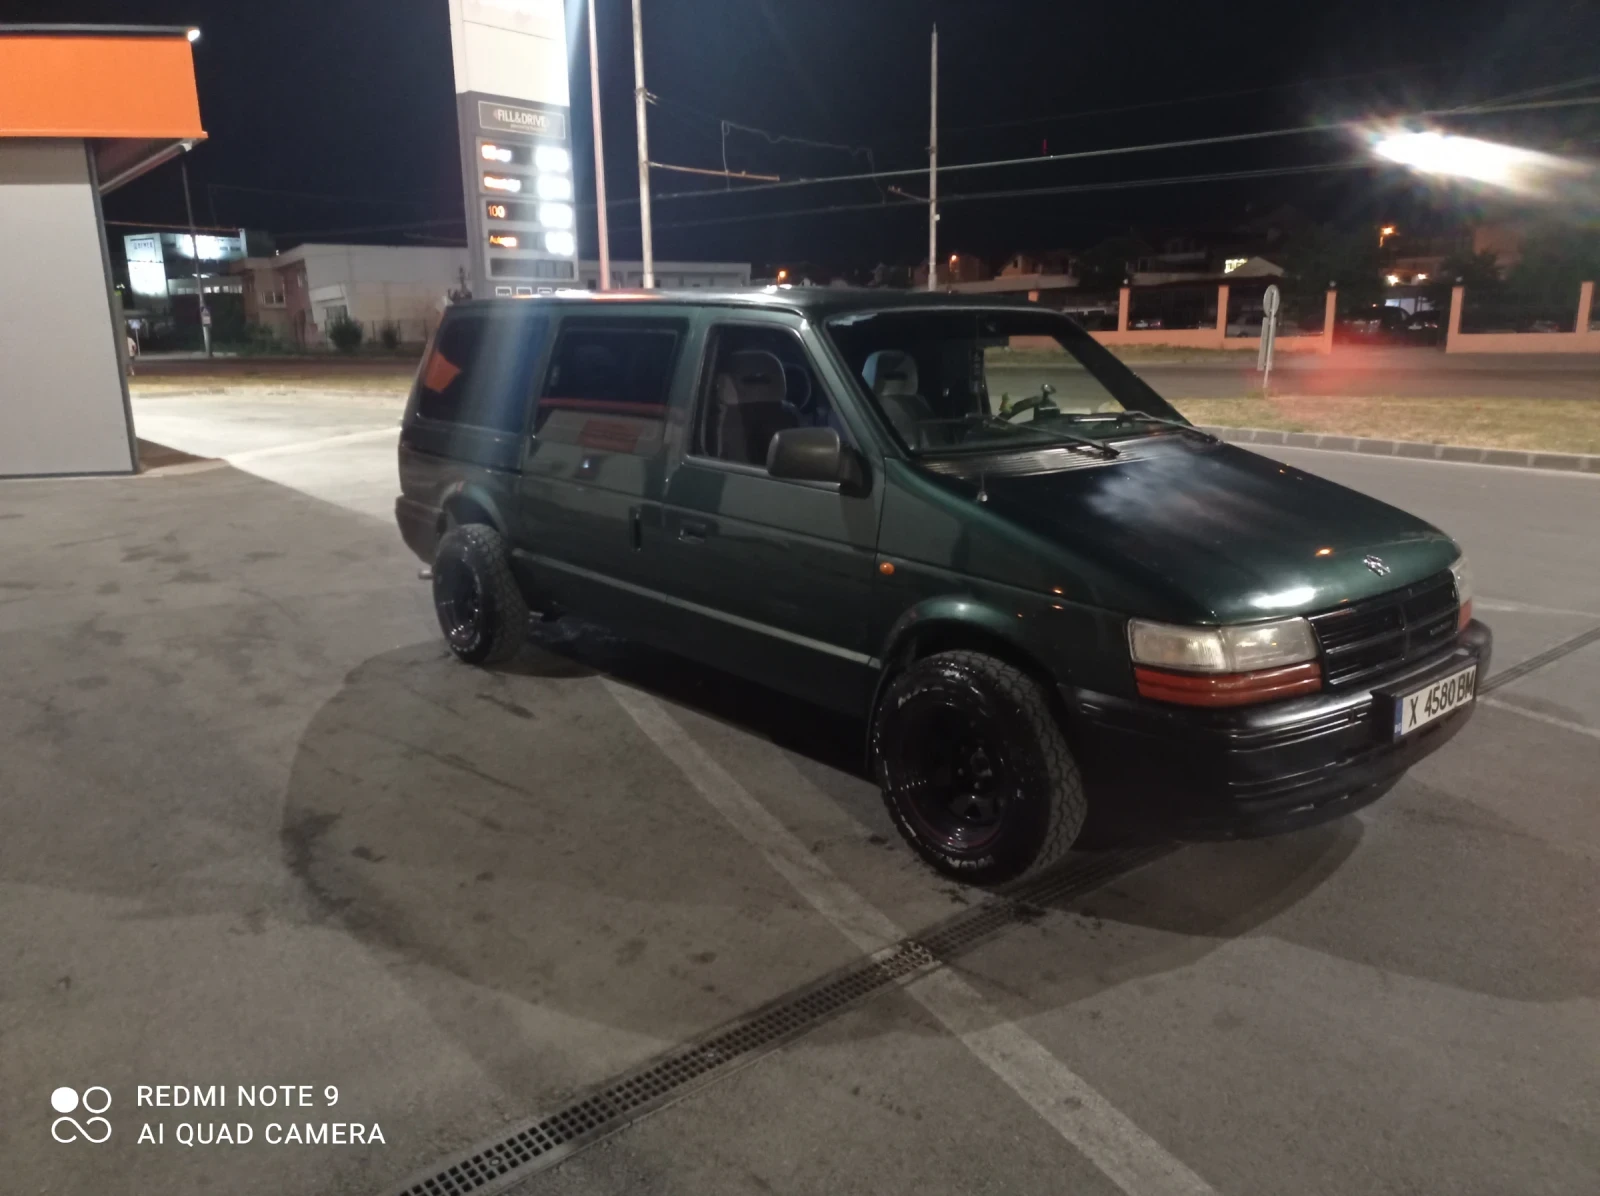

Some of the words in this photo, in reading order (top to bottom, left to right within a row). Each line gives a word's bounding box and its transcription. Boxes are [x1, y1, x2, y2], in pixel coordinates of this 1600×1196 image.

[497, 109, 547, 127] FILL&DRIVE
[1409, 695, 1419, 728] X
[1424, 678, 1456, 717] 4580
[1457, 670, 1475, 702] BM
